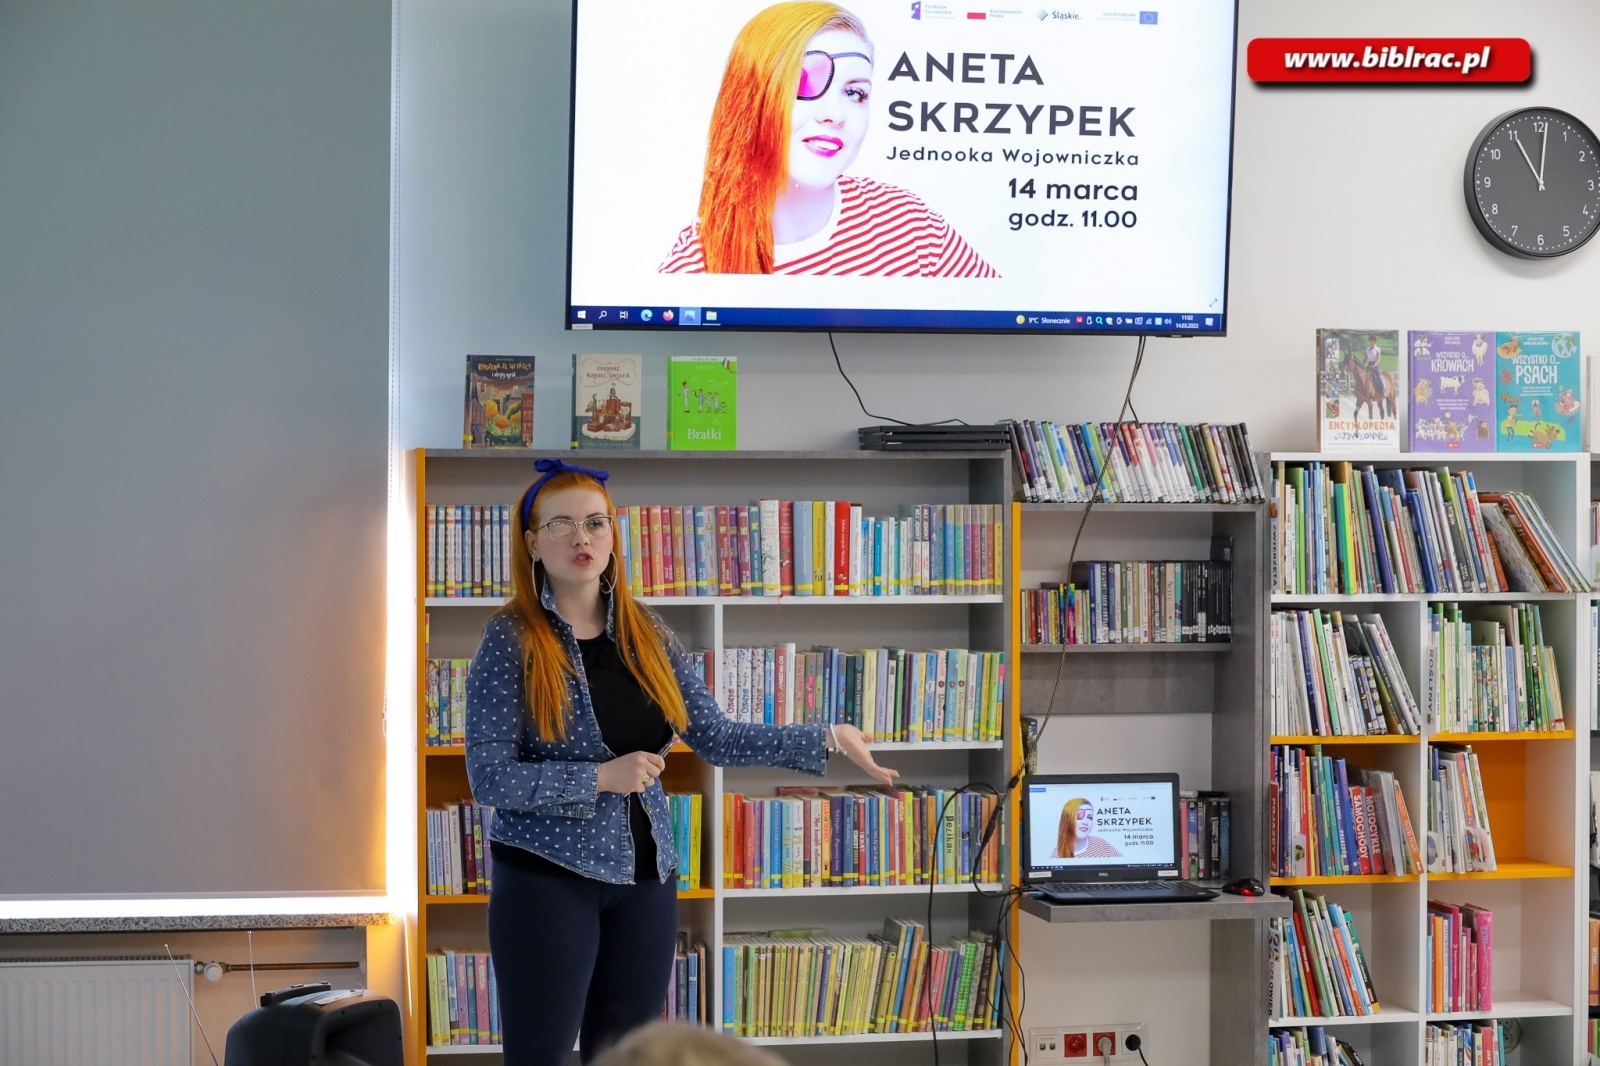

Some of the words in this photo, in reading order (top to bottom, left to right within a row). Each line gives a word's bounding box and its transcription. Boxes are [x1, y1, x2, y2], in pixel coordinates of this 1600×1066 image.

[888, 50, 1044, 86] ANETA
[888, 100, 1136, 137] SKRZYPEK
[1533, 122, 1544, 133] 12
[1508, 130, 1518, 141] 11
[1562, 131, 1568, 142] 1
[886, 146, 993, 162] Jednooka
[1002, 148, 1139, 167] Wojowniczka
[1490, 149, 1501, 161] 10
[1579, 151, 1586, 162] 2
[1484, 177, 1491, 188] 9
[1588, 180, 1595, 192] 3
[1008, 178, 1036, 198] 14
[1046, 183, 1138, 201] marca
[1491, 204, 1499, 215] 8
[1582, 205, 1589, 216] 4
[1008, 210, 1074, 230] godz.
[1082, 210, 1138, 228] 11.00
[1511, 225, 1519, 237] 7
[1562, 226, 1570, 237] 5
[1537, 234, 1544, 246] 6
[1431, 358, 1474, 372] KROWACH
[1512, 355, 1547, 364] WSZYSTKO
[1515, 365, 1558, 384] PSACH
[1328, 421, 1395, 430] ENCYKLOPEDIA
[687, 427, 722, 440] Bratki
[1427, 649, 1435, 712] ROŚLINY
[1096, 807, 1131, 815] ANETA
[1097, 818, 1152, 826] SKRZYPEK
[1354, 795, 1368, 858] SAMOCHODY
[1365, 796, 1380, 855] MOTOCYKLE
